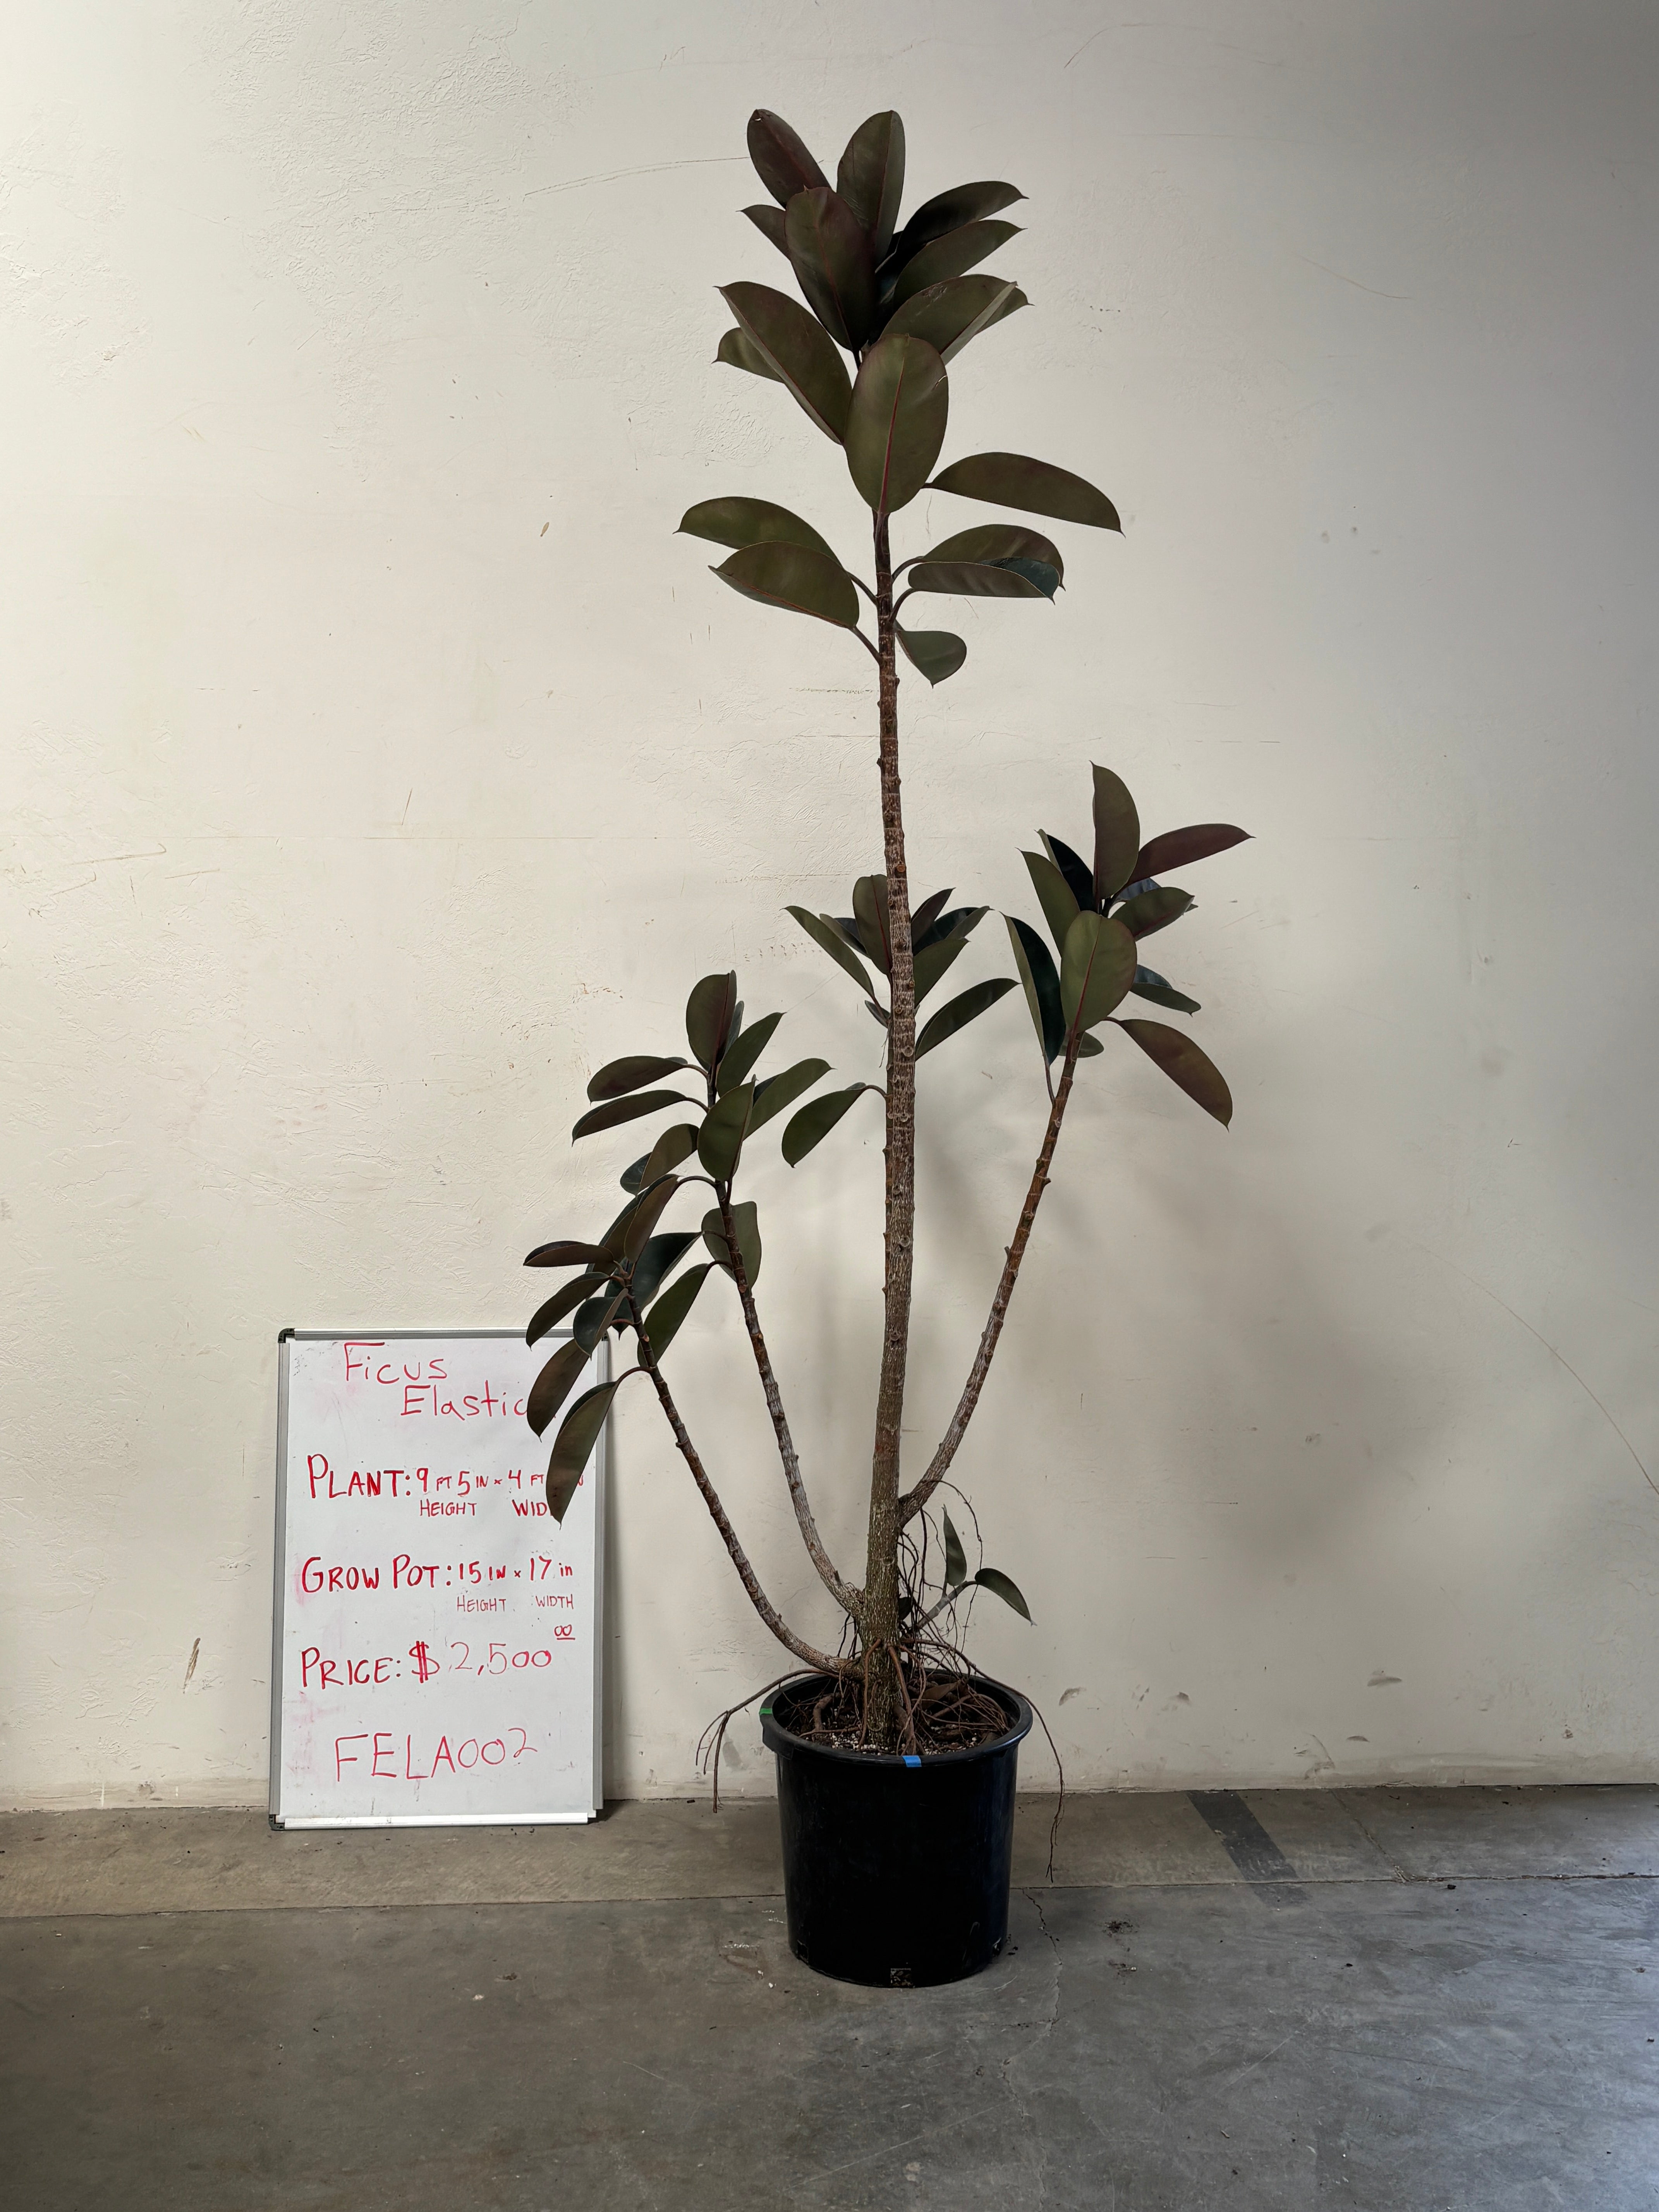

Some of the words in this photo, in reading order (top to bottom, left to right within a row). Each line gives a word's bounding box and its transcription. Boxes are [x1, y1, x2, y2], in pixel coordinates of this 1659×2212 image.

[343, 1341, 447, 1384] Ficus
[400, 1380, 556, 1420] Elastic
[307, 1453, 411, 1499] PLANT:
[416, 1467, 429, 1492] 9
[436, 1476, 452, 1491] FT
[457, 1470, 471, 1496] 5
[476, 1475, 489, 1488] IN
[508, 1470, 522, 1489] 4
[530, 1474, 544, 1486] FT
[420, 1498, 477, 1517] HEIGHT
[512, 1499, 554, 1517] WID
[301, 1556, 380, 1594] GROW
[392, 1554, 452, 1589] POT:
[459, 1561, 482, 1585] 15
[530, 1556, 552, 1581] 17
[559, 1562, 573, 1577] in
[457, 1595, 506, 1612] HEIGHT
[534, 1595, 574, 1609] WIDTH
[301, 1647, 401, 1690] PRICE:
[334, 1728, 538, 1782] FELA002
